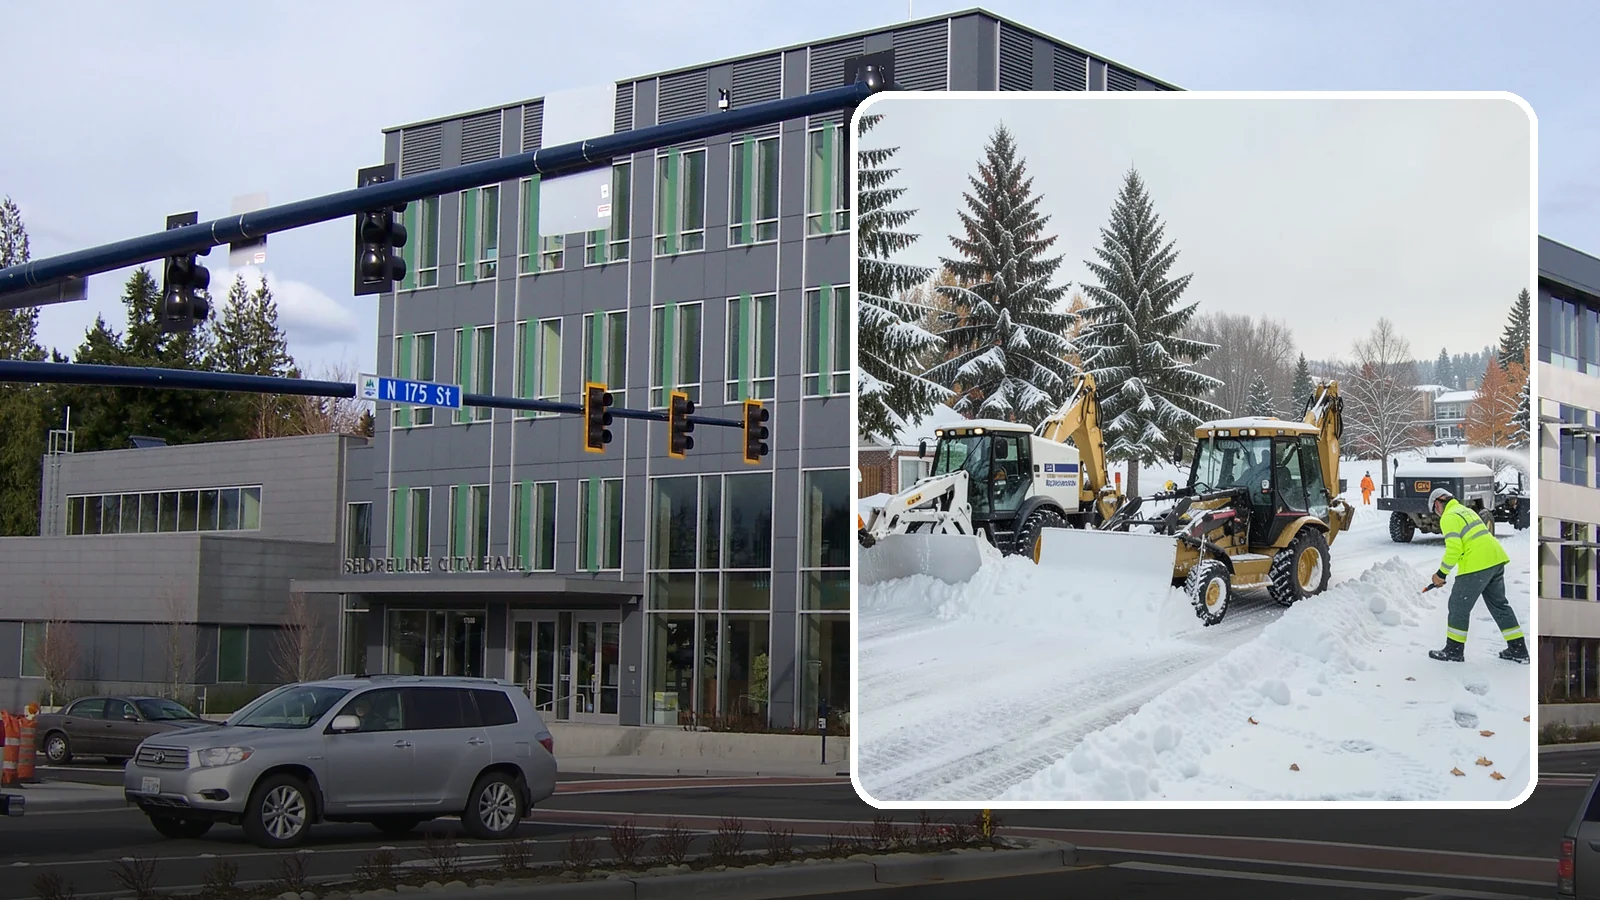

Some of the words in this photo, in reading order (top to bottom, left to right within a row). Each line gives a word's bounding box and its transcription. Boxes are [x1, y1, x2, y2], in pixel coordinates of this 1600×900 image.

[387, 380, 396, 400] N
[405, 382, 427, 403] 175
[436, 386, 451, 406] St
[344, 556, 432, 575] SHORELINE
[438, 556, 475, 573] CITY
[483, 555, 526, 572] HALL
